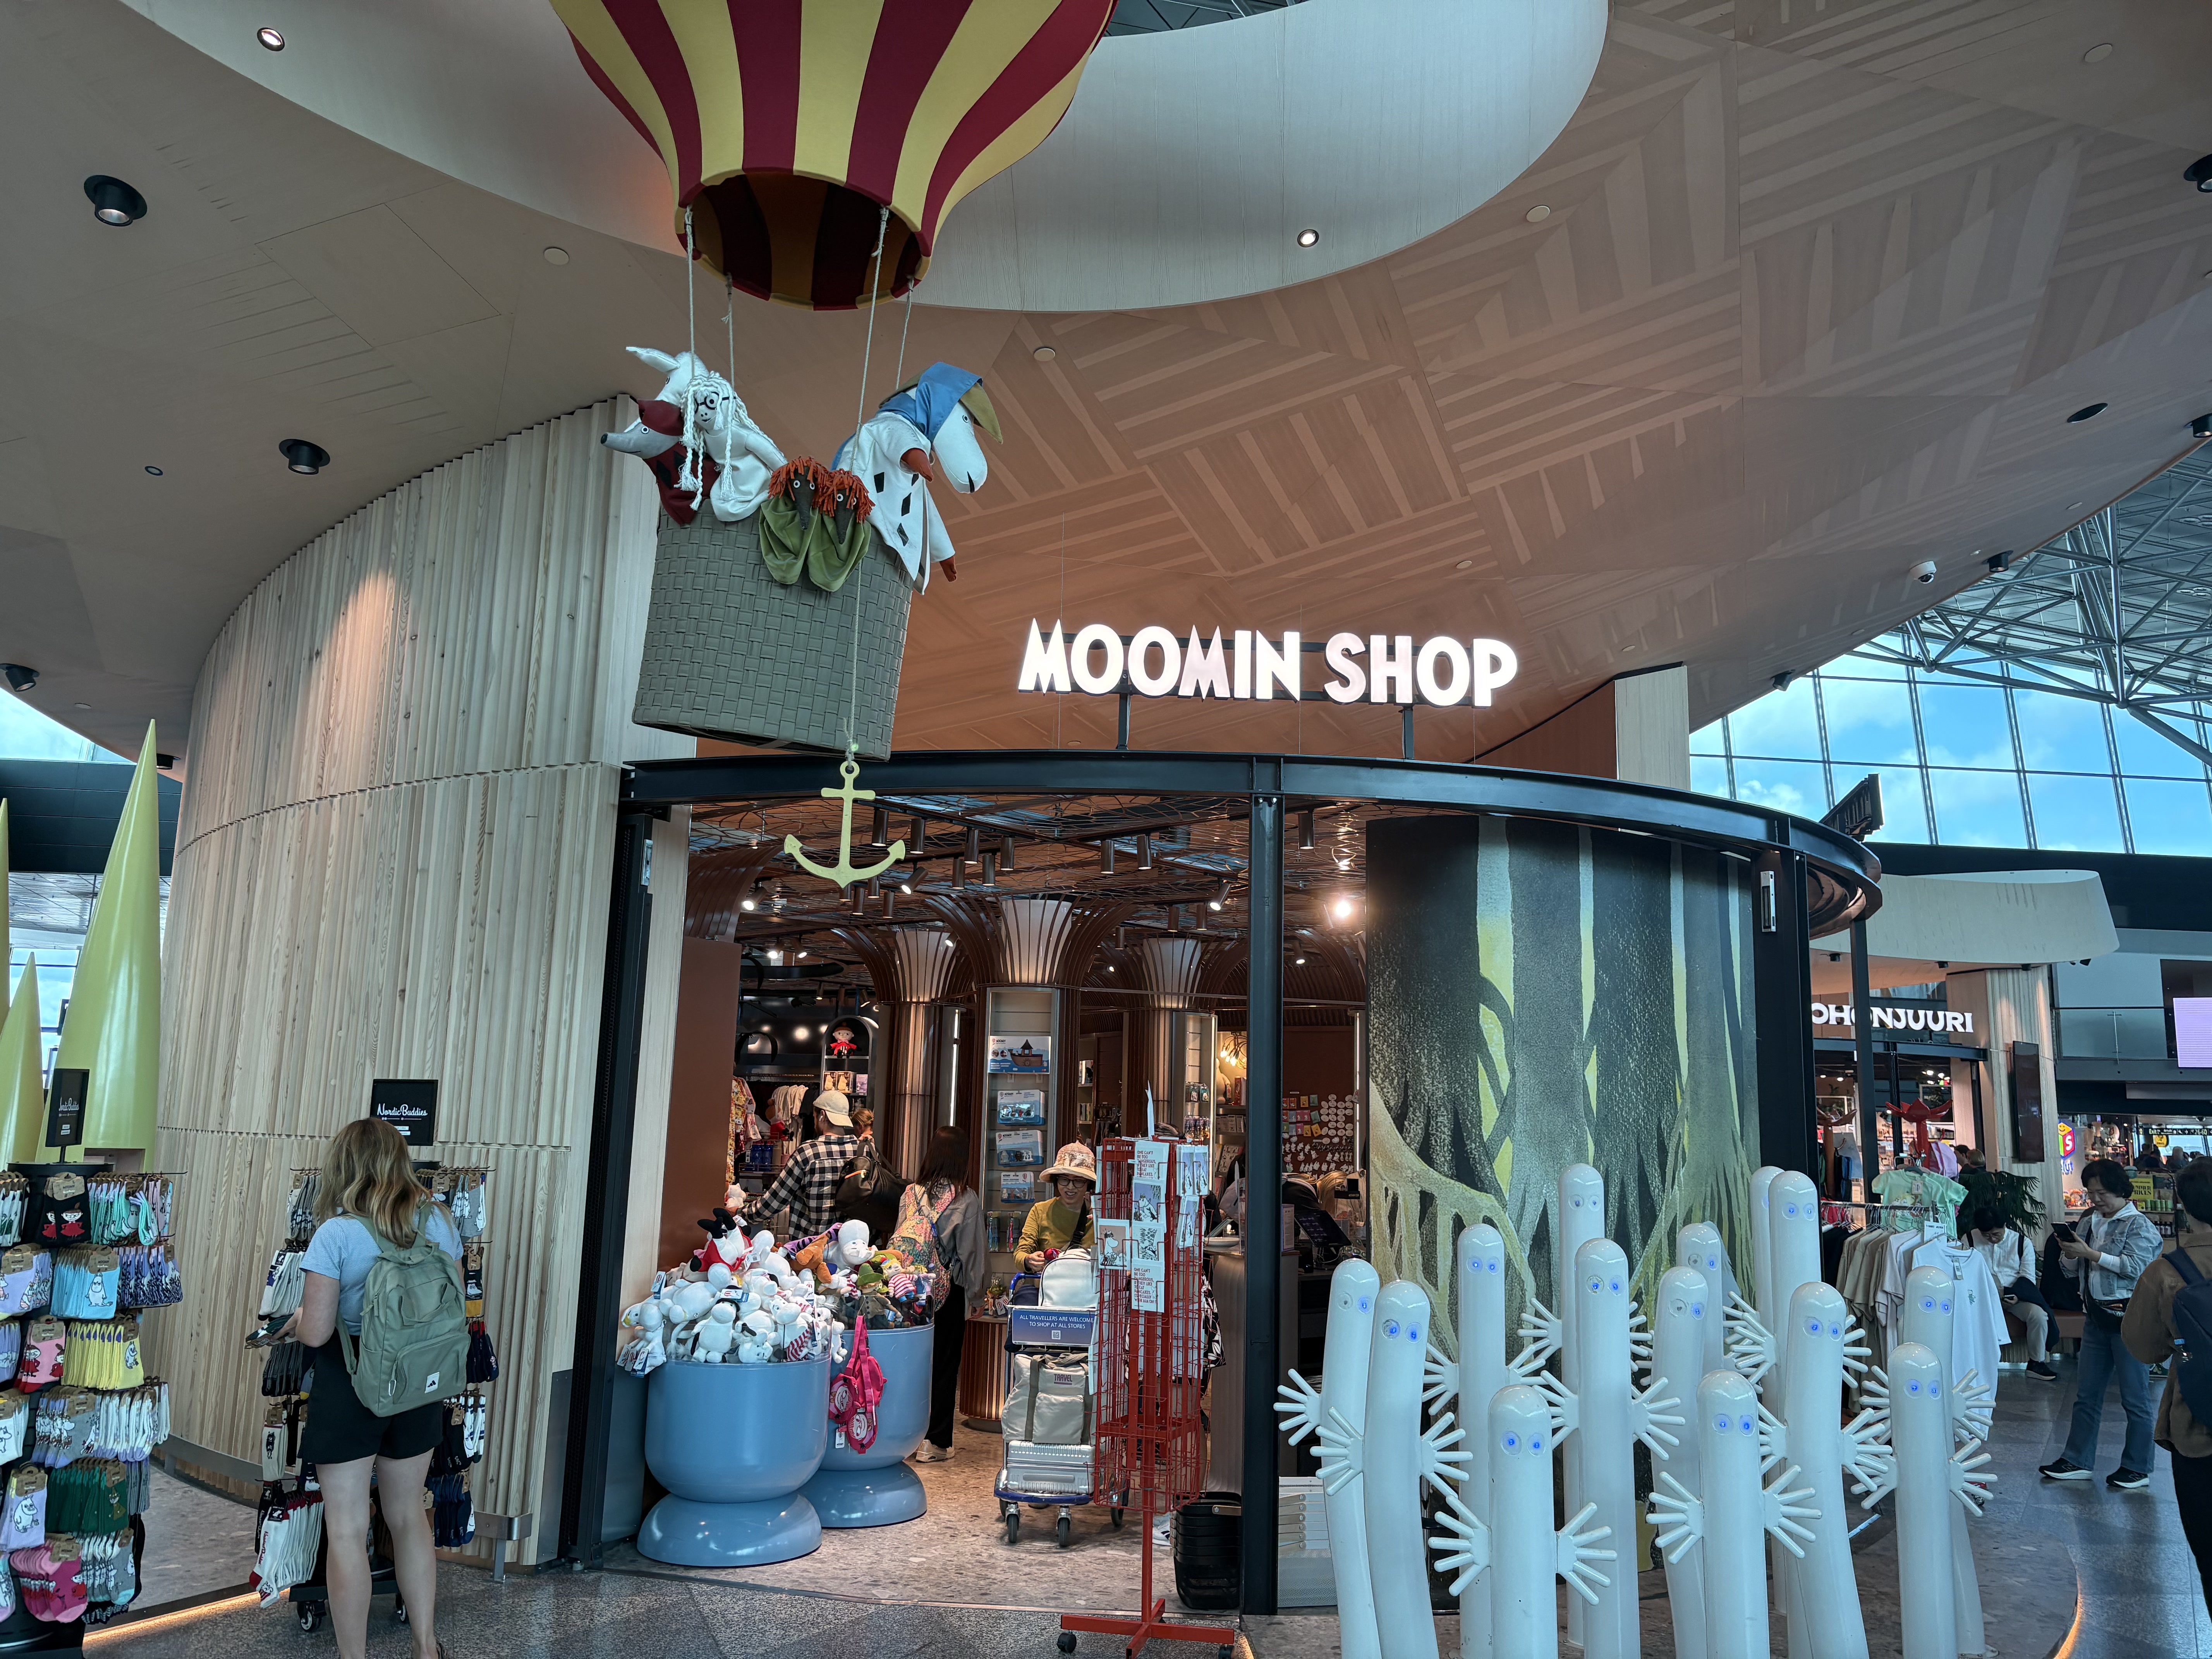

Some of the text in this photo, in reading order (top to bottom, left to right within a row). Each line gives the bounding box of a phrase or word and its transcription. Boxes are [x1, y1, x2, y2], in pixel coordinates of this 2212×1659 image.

[1018, 618, 1517, 707] MOOMIN SHOP
[1812, 1003, 1973, 1032] OHNJUURI
[2065, 1135, 2073, 1151] S
[1054, 1374, 1072, 1382] TRAVEL
